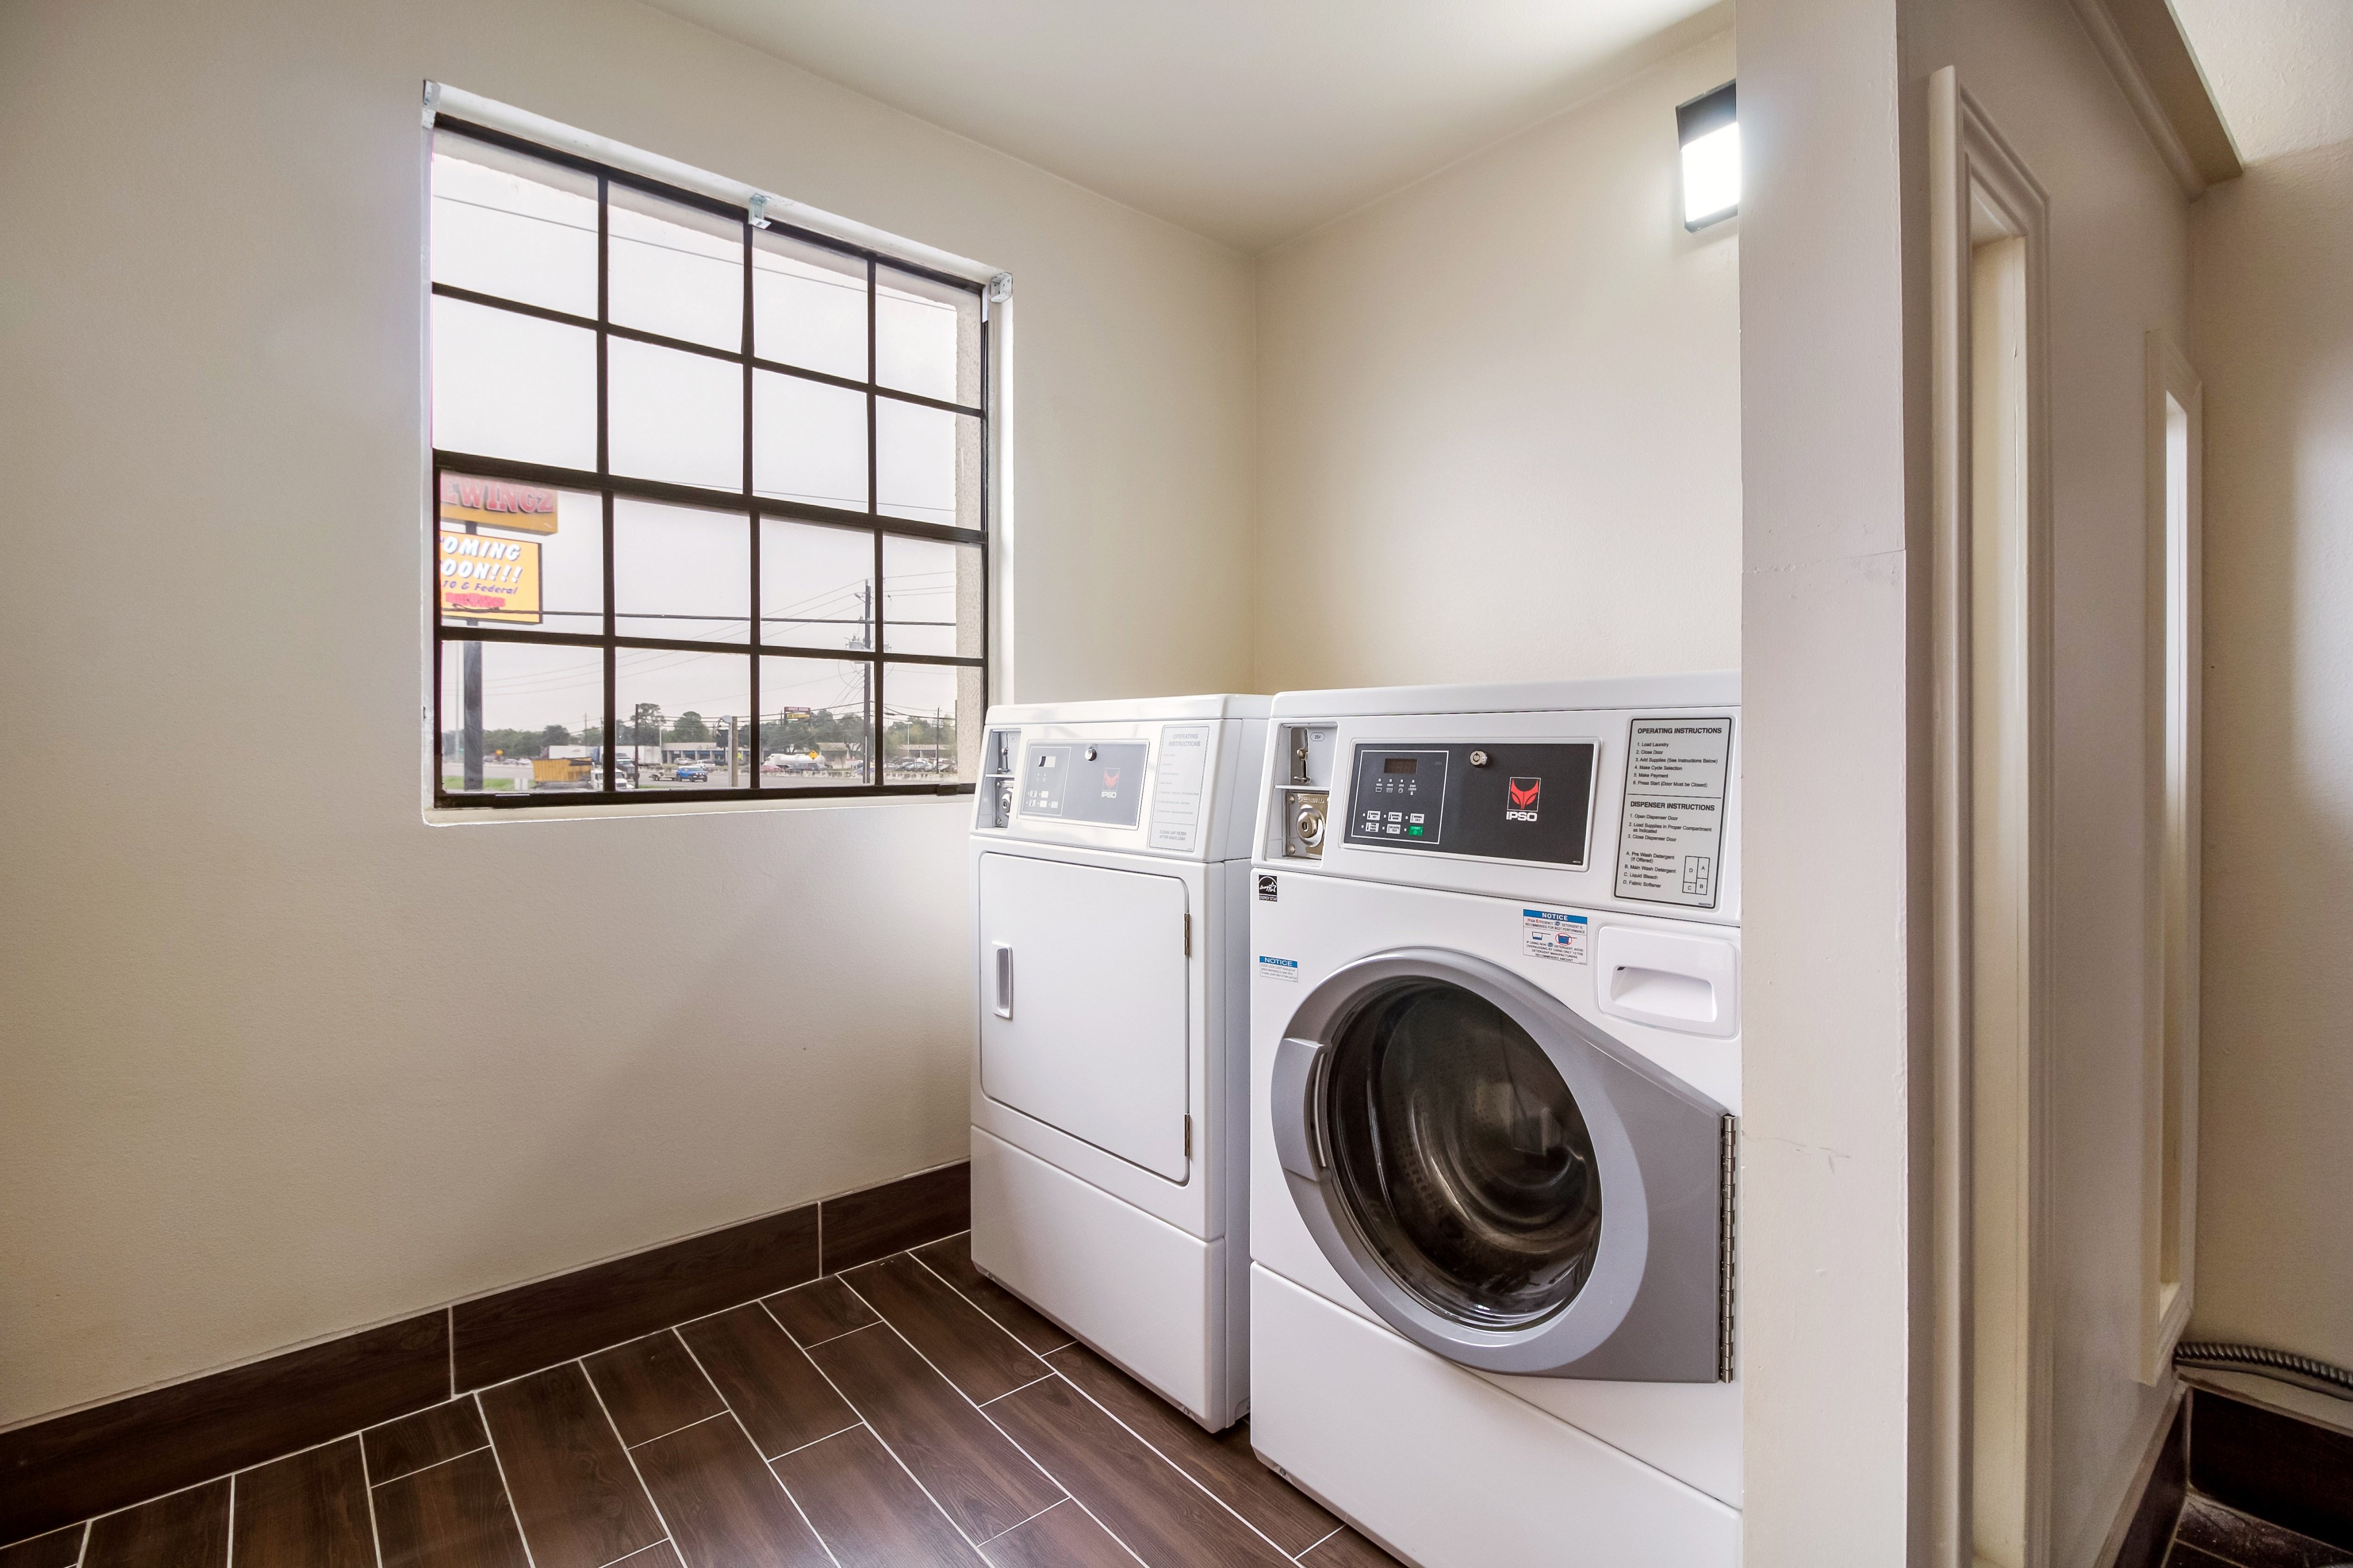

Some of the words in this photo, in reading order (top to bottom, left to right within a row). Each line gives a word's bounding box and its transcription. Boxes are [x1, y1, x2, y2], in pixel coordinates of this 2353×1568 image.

[440, 536, 521, 561] OMING
[440, 558, 523, 583] OON!!!
[474, 583, 518, 594] Federal
[1666, 803, 1715, 811] INSTRUCTIONS
[1506, 811, 1537, 821] IPSO
[1264, 957, 1293, 966] NOTICE
